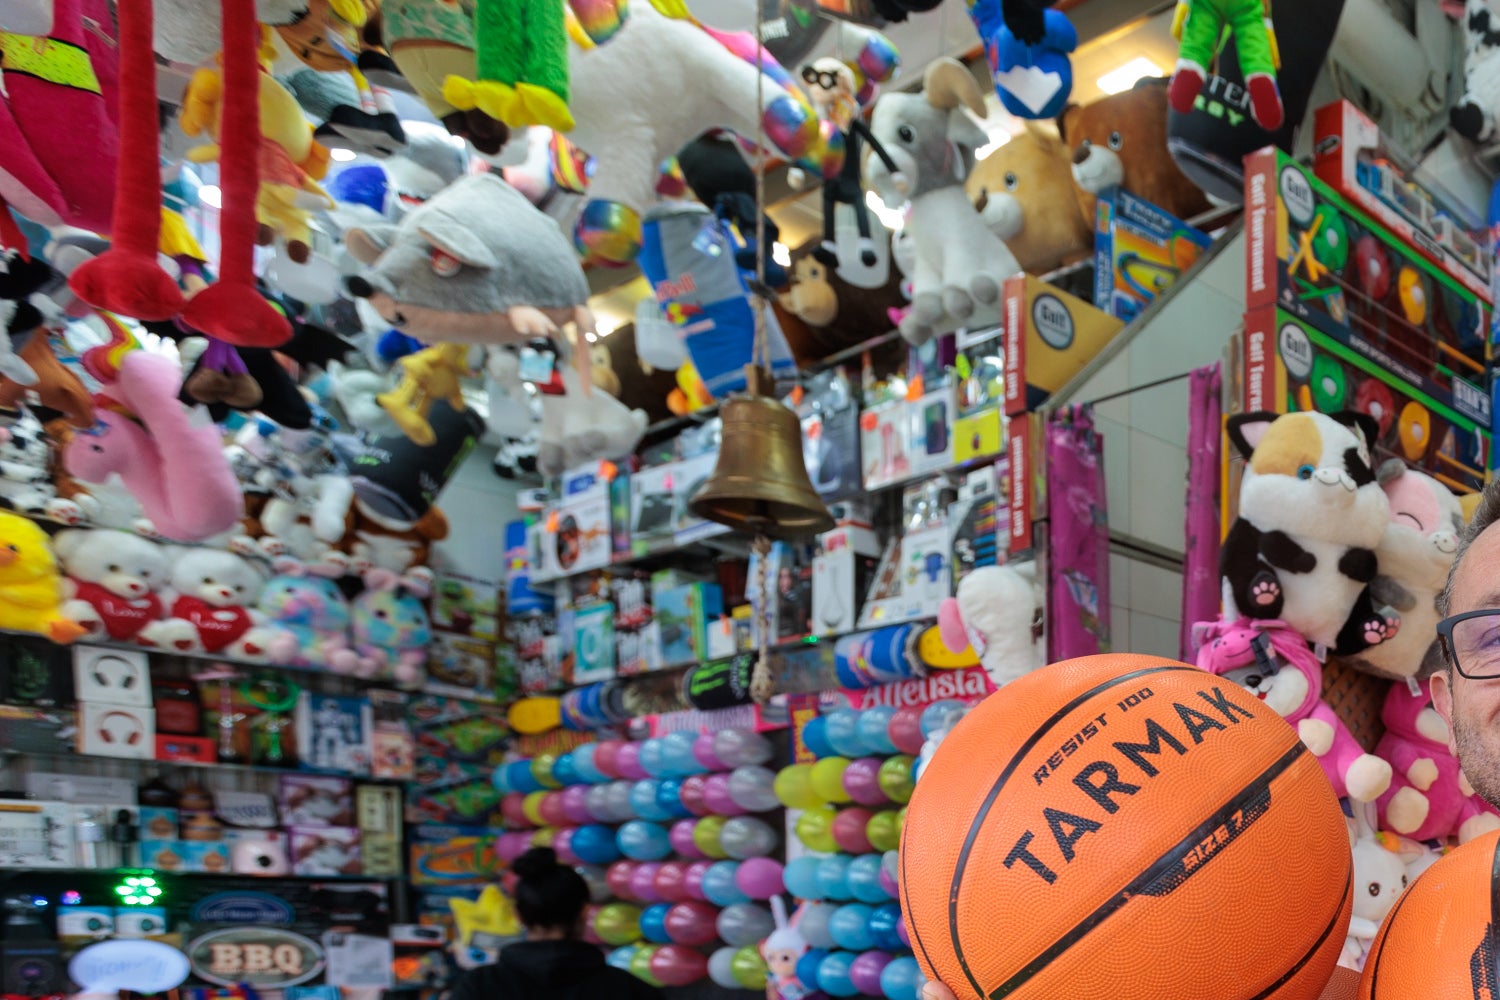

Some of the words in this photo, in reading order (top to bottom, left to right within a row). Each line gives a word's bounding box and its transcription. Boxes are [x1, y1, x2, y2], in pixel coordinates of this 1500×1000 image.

[1252, 173, 1265, 205] Golf
[1032, 713, 1109, 787] RESIST
[1116, 686, 1156, 713] 100
[1002, 686, 1255, 887] TARMAK
[1182, 825, 1230, 873] SIZE
[210, 942, 303, 976] BBQ
